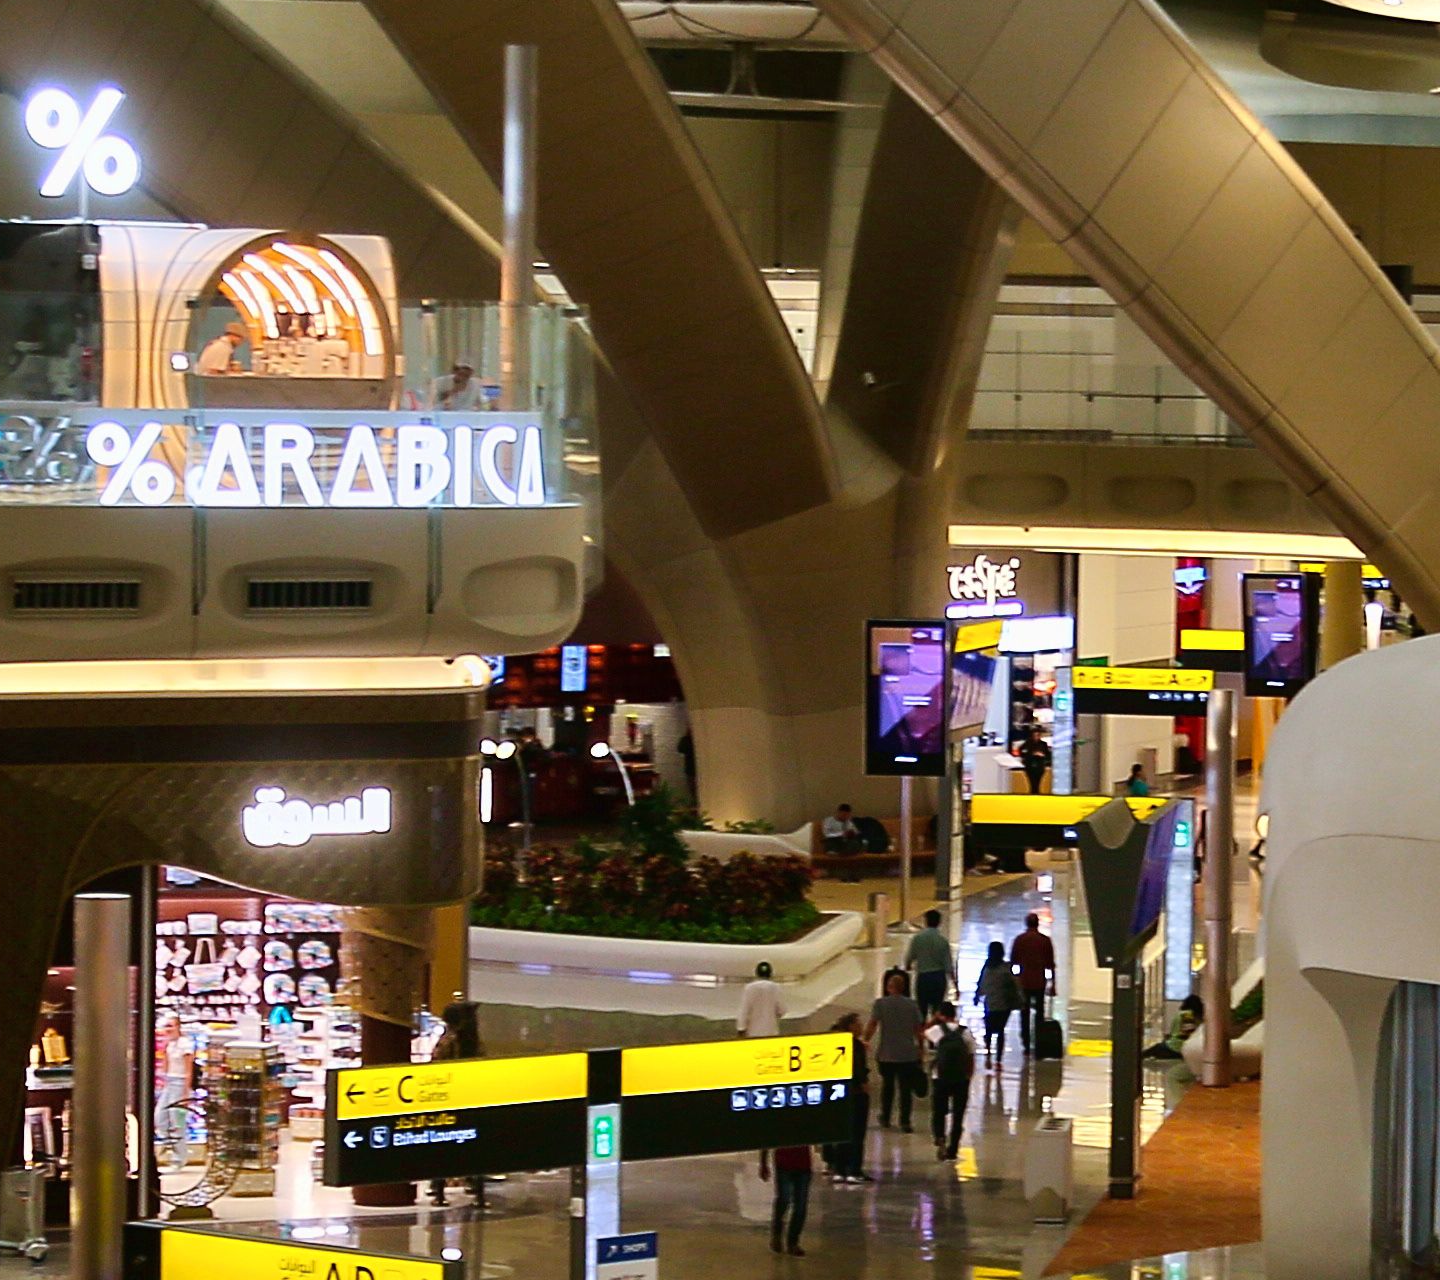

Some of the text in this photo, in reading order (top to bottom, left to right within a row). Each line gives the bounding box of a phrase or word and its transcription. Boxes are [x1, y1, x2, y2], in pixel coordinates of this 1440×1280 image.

[198, 423, 546, 507] ARABICA
[242, 787, 391, 847] السوق
[789, 1045, 801, 1072] B
[398, 1075, 413, 1103] C
[393, 1128, 477, 1147] Etihad Lounges
